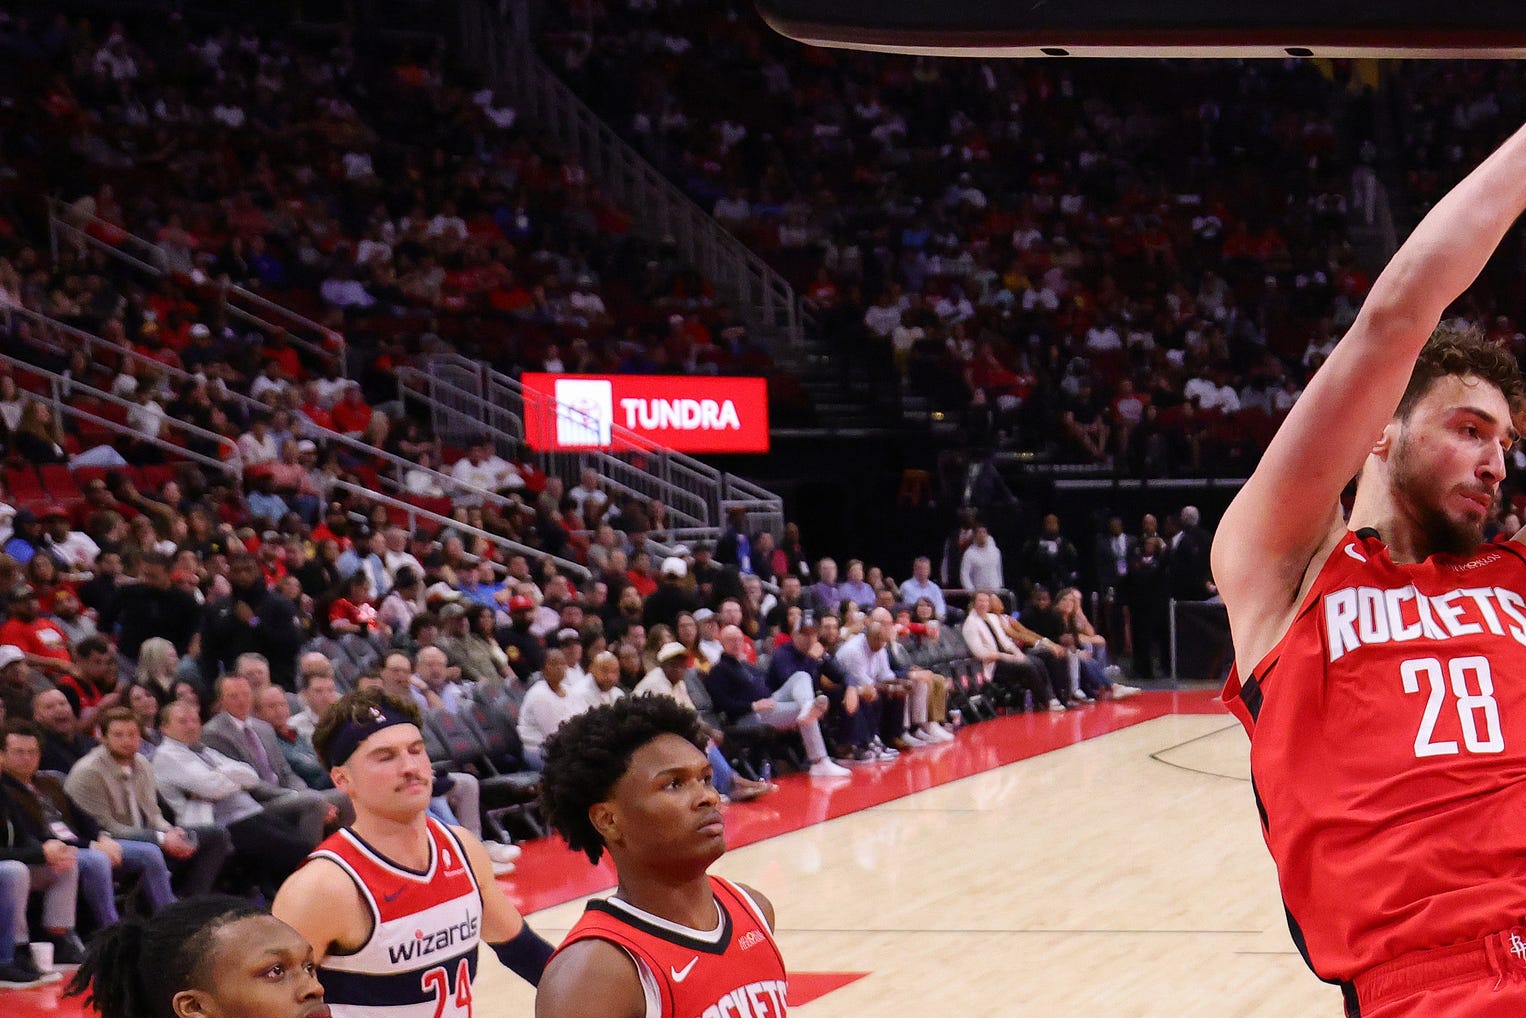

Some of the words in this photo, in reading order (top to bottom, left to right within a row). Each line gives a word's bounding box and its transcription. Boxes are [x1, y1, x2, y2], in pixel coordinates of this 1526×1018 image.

[620, 398, 741, 430] TUNDRA
[1400, 655, 1505, 757] 28
[388, 908, 478, 965] wizards
